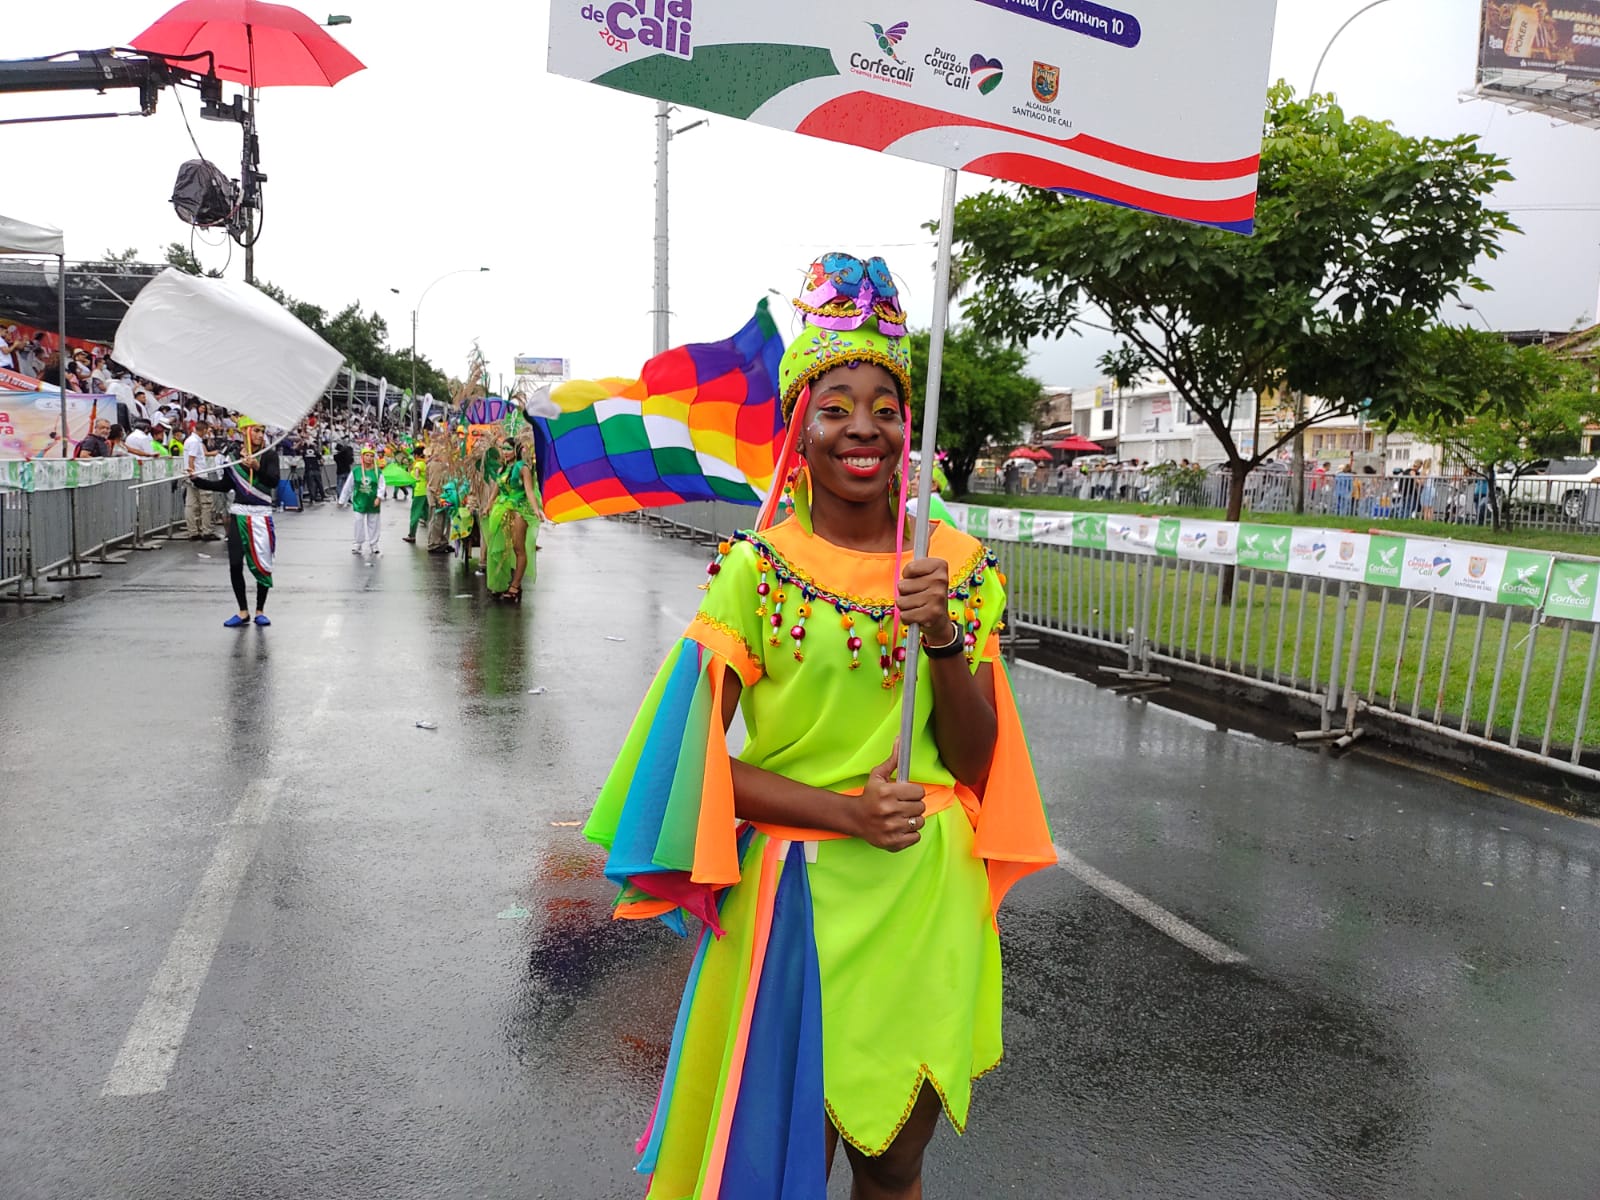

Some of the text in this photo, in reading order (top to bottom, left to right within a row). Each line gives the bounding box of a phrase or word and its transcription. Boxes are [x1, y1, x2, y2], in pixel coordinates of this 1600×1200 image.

[581, 2, 691, 56] de Cali
[1112, 17, 1124, 35] 10
[598, 27, 629, 53] 2021
[1514, 20, 1528, 53] POKER
[933, 47, 957, 62] Puro
[850, 52, 915, 82] Corfecali
[924, 54, 969, 75] Corazón
[933, 68, 946, 76] por
[945, 72, 971, 90] Cali
[1012, 106, 1072, 128] SANTIAGO DE CALI
[1502, 582, 1540, 596] Corfecali
[1550, 593, 1591, 607] Corfecali
